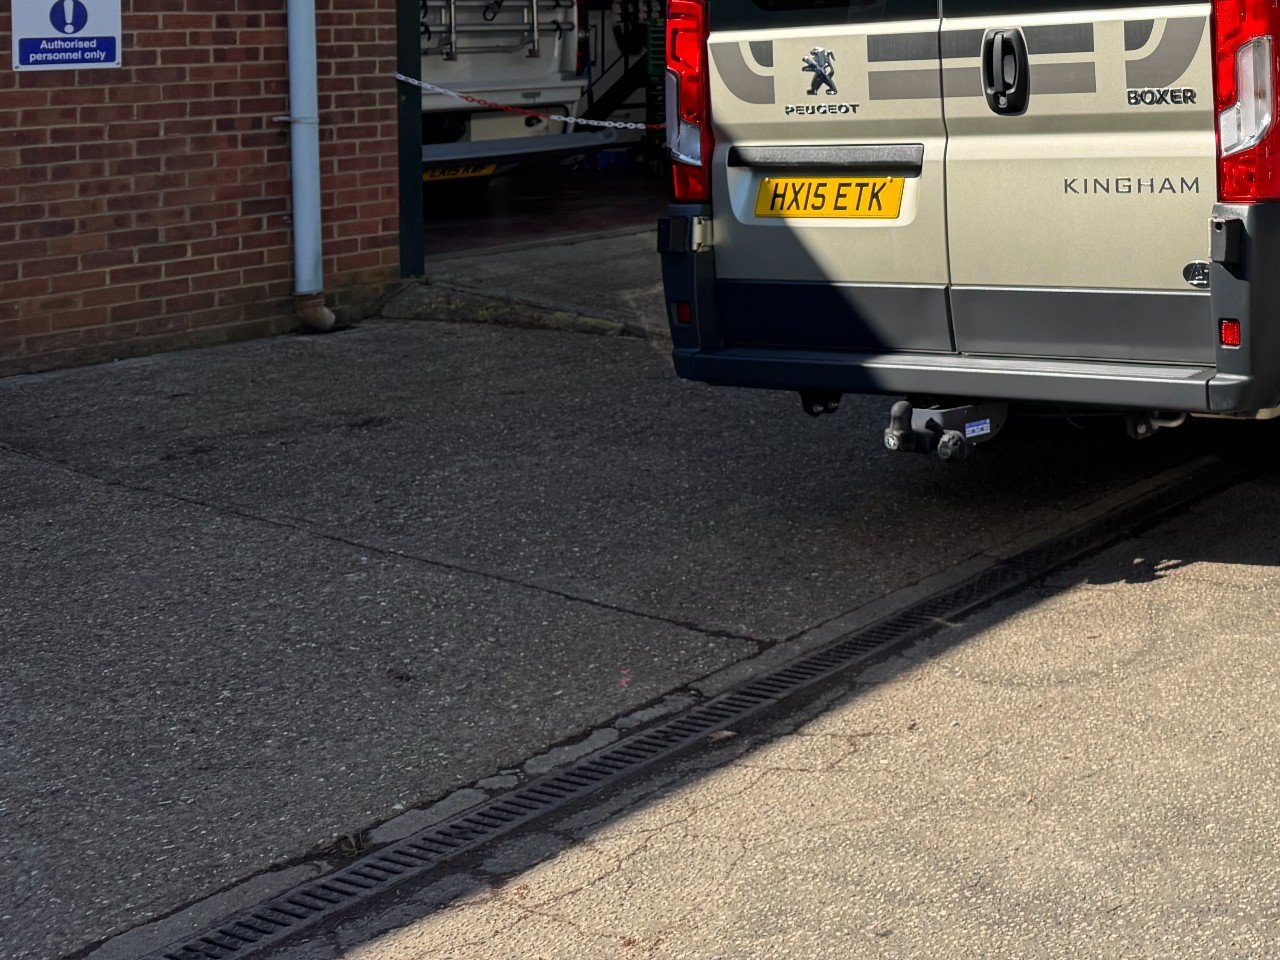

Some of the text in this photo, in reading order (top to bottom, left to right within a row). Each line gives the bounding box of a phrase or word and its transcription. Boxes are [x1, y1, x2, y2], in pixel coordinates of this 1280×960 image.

[40, 39, 97, 50] Authorised
[29, 50, 106, 63] personnel only
[1127, 87, 1197, 106] BOXER
[784, 102, 860, 116] PEUGEOT
[1063, 176, 1201, 195] KINGHAM
[769, 181, 888, 212] HX15 ETK
